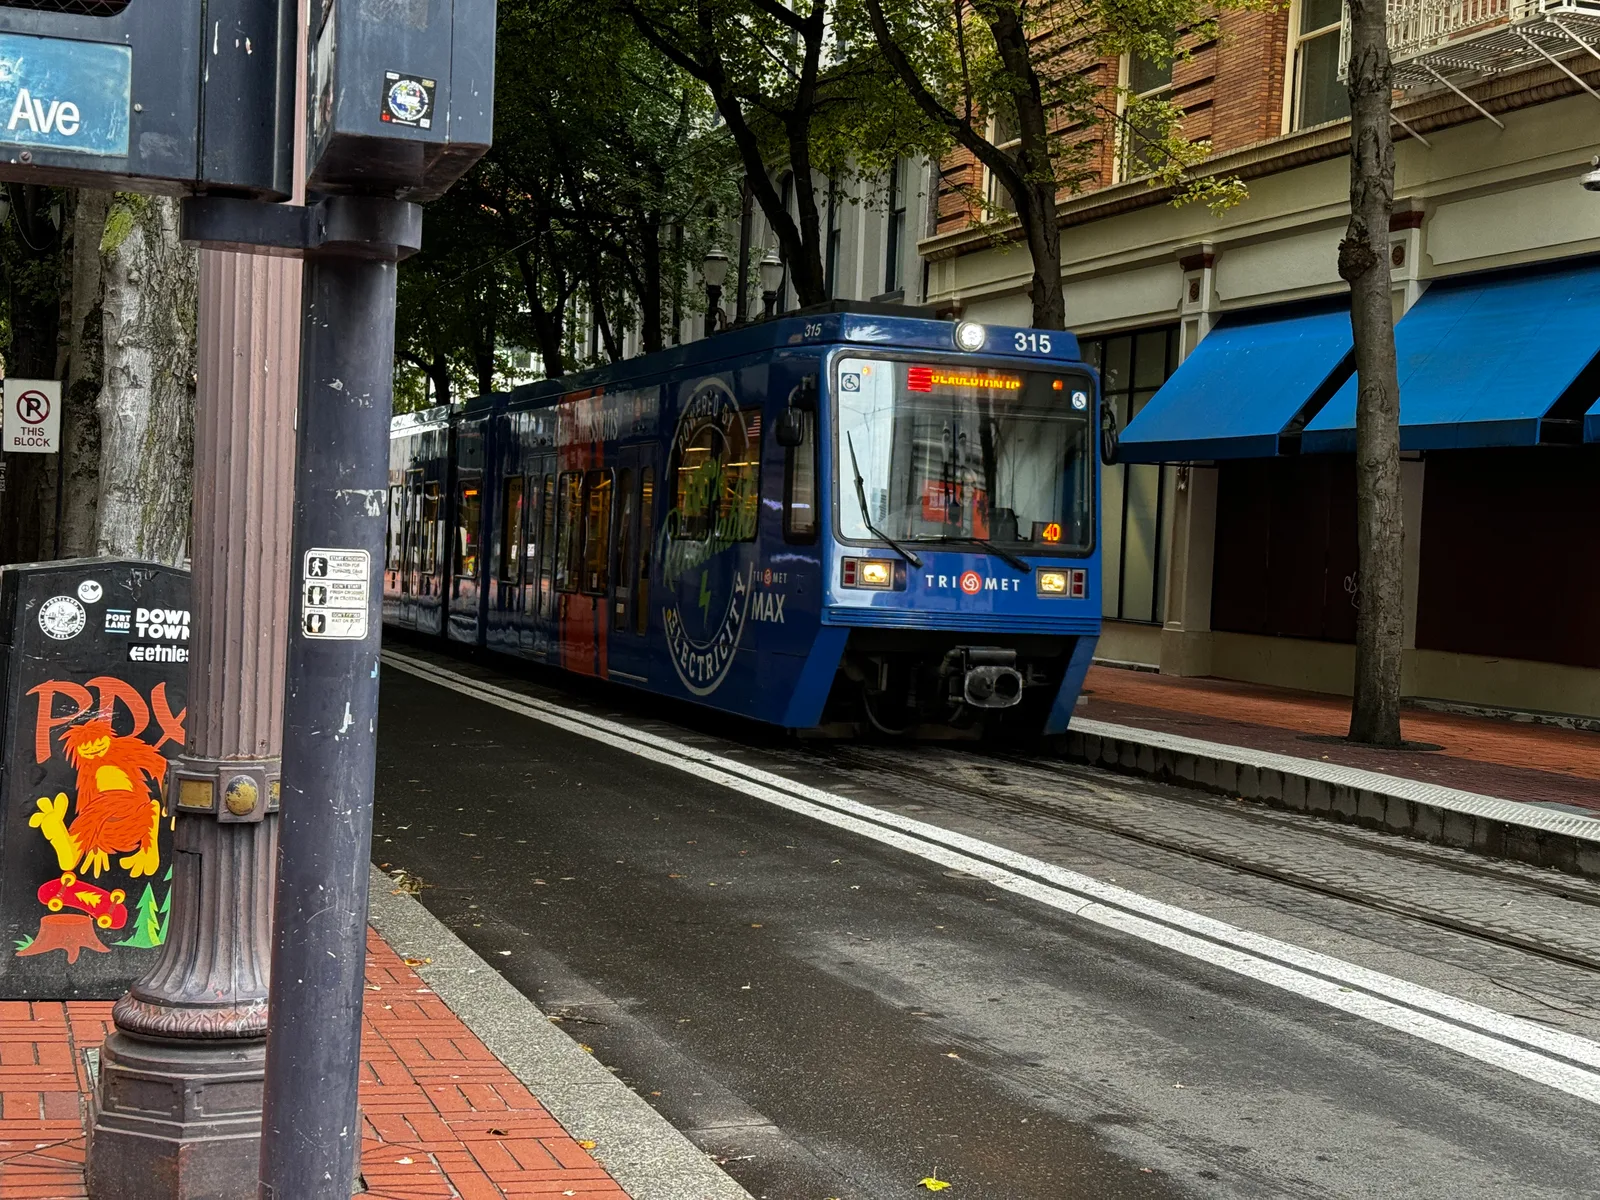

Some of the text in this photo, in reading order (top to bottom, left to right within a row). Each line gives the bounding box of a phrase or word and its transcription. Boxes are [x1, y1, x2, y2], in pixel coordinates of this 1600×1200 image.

[7, 88, 80, 136] Ave
[805, 324, 821, 336] 315
[1015, 332, 1051, 353] 315
[21, 427, 45, 437] THIS
[14, 437, 50, 447] BLOCK
[1043, 523, 1061, 542] 40
[772, 573, 787, 584] MET
[925, 574, 1020, 592] TRI MET
[751, 591, 785, 624] MAX
[105, 614, 131, 622] PORT
[105, 621, 130, 629] LAND
[666, 572, 746, 681] ELECTRICITY
[25, 676, 187, 764] PDX
